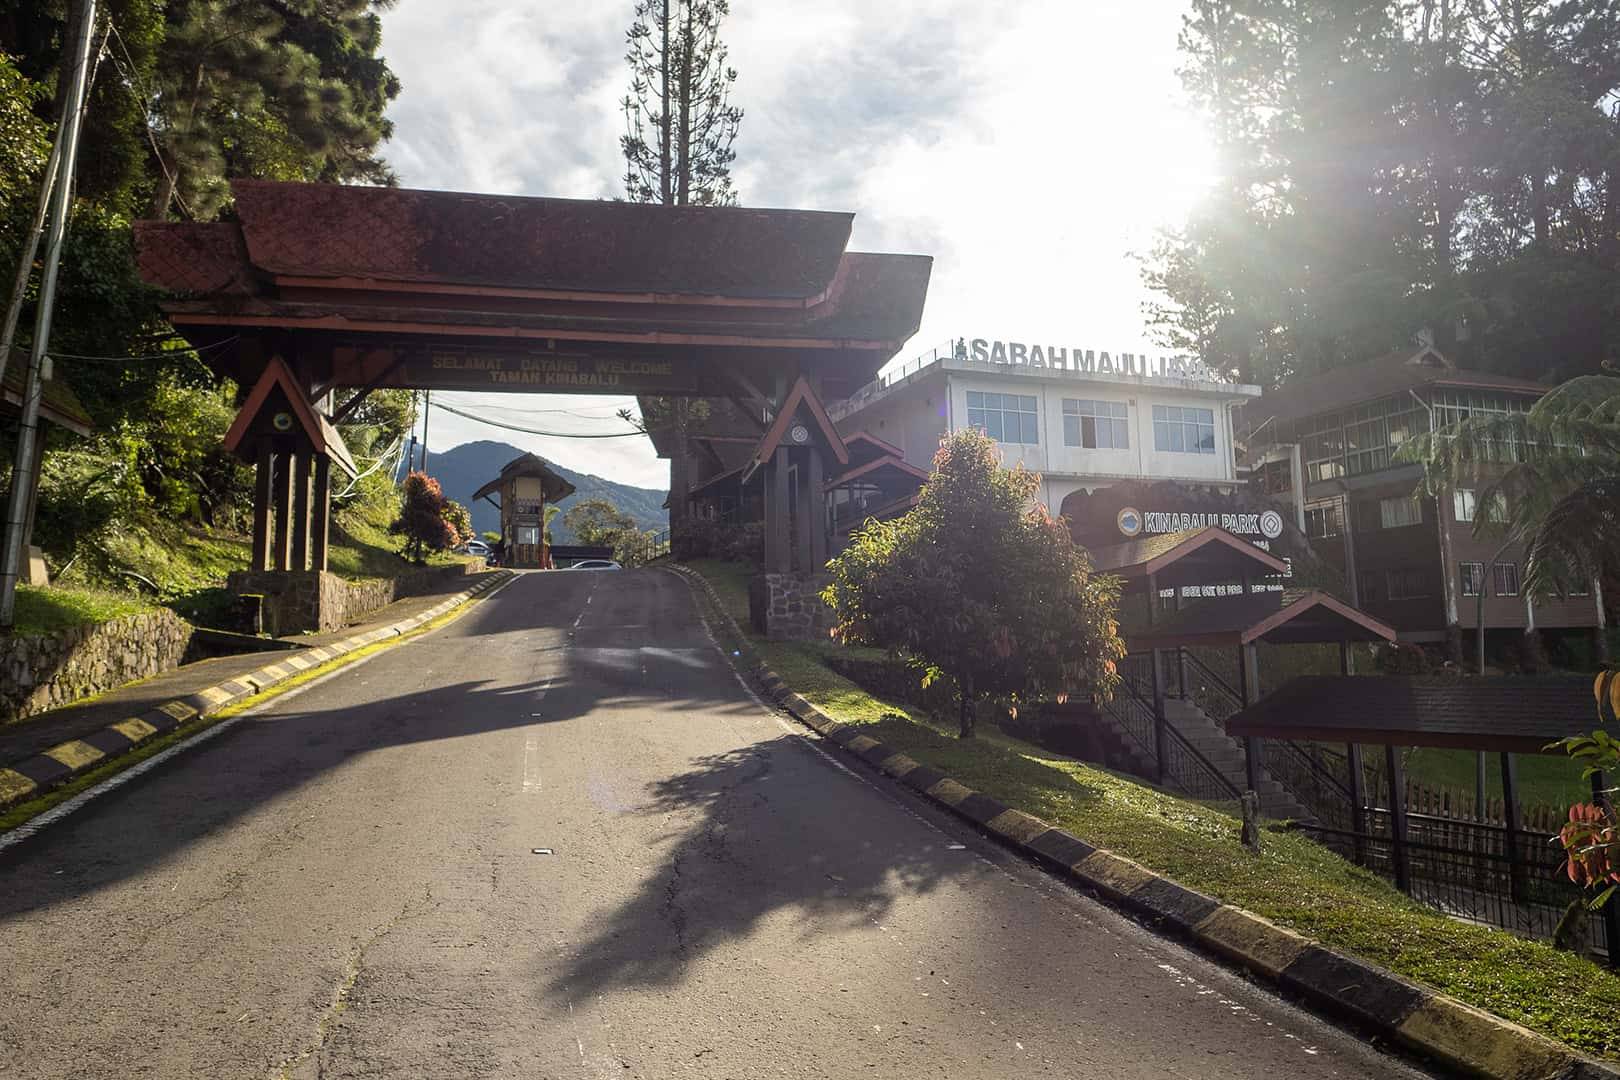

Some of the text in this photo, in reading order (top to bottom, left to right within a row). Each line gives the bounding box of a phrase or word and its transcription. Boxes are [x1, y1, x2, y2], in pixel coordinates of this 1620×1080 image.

[432, 357, 672, 375] SELAMAT DATANG WELCOME
[971, 338, 1067, 369] SABAH
[1073, 348, 1146, 377] MAJU
[489, 370, 619, 386] TAMAN KINABALU
[1144, 512, 1260, 534] KINABALU PARK
